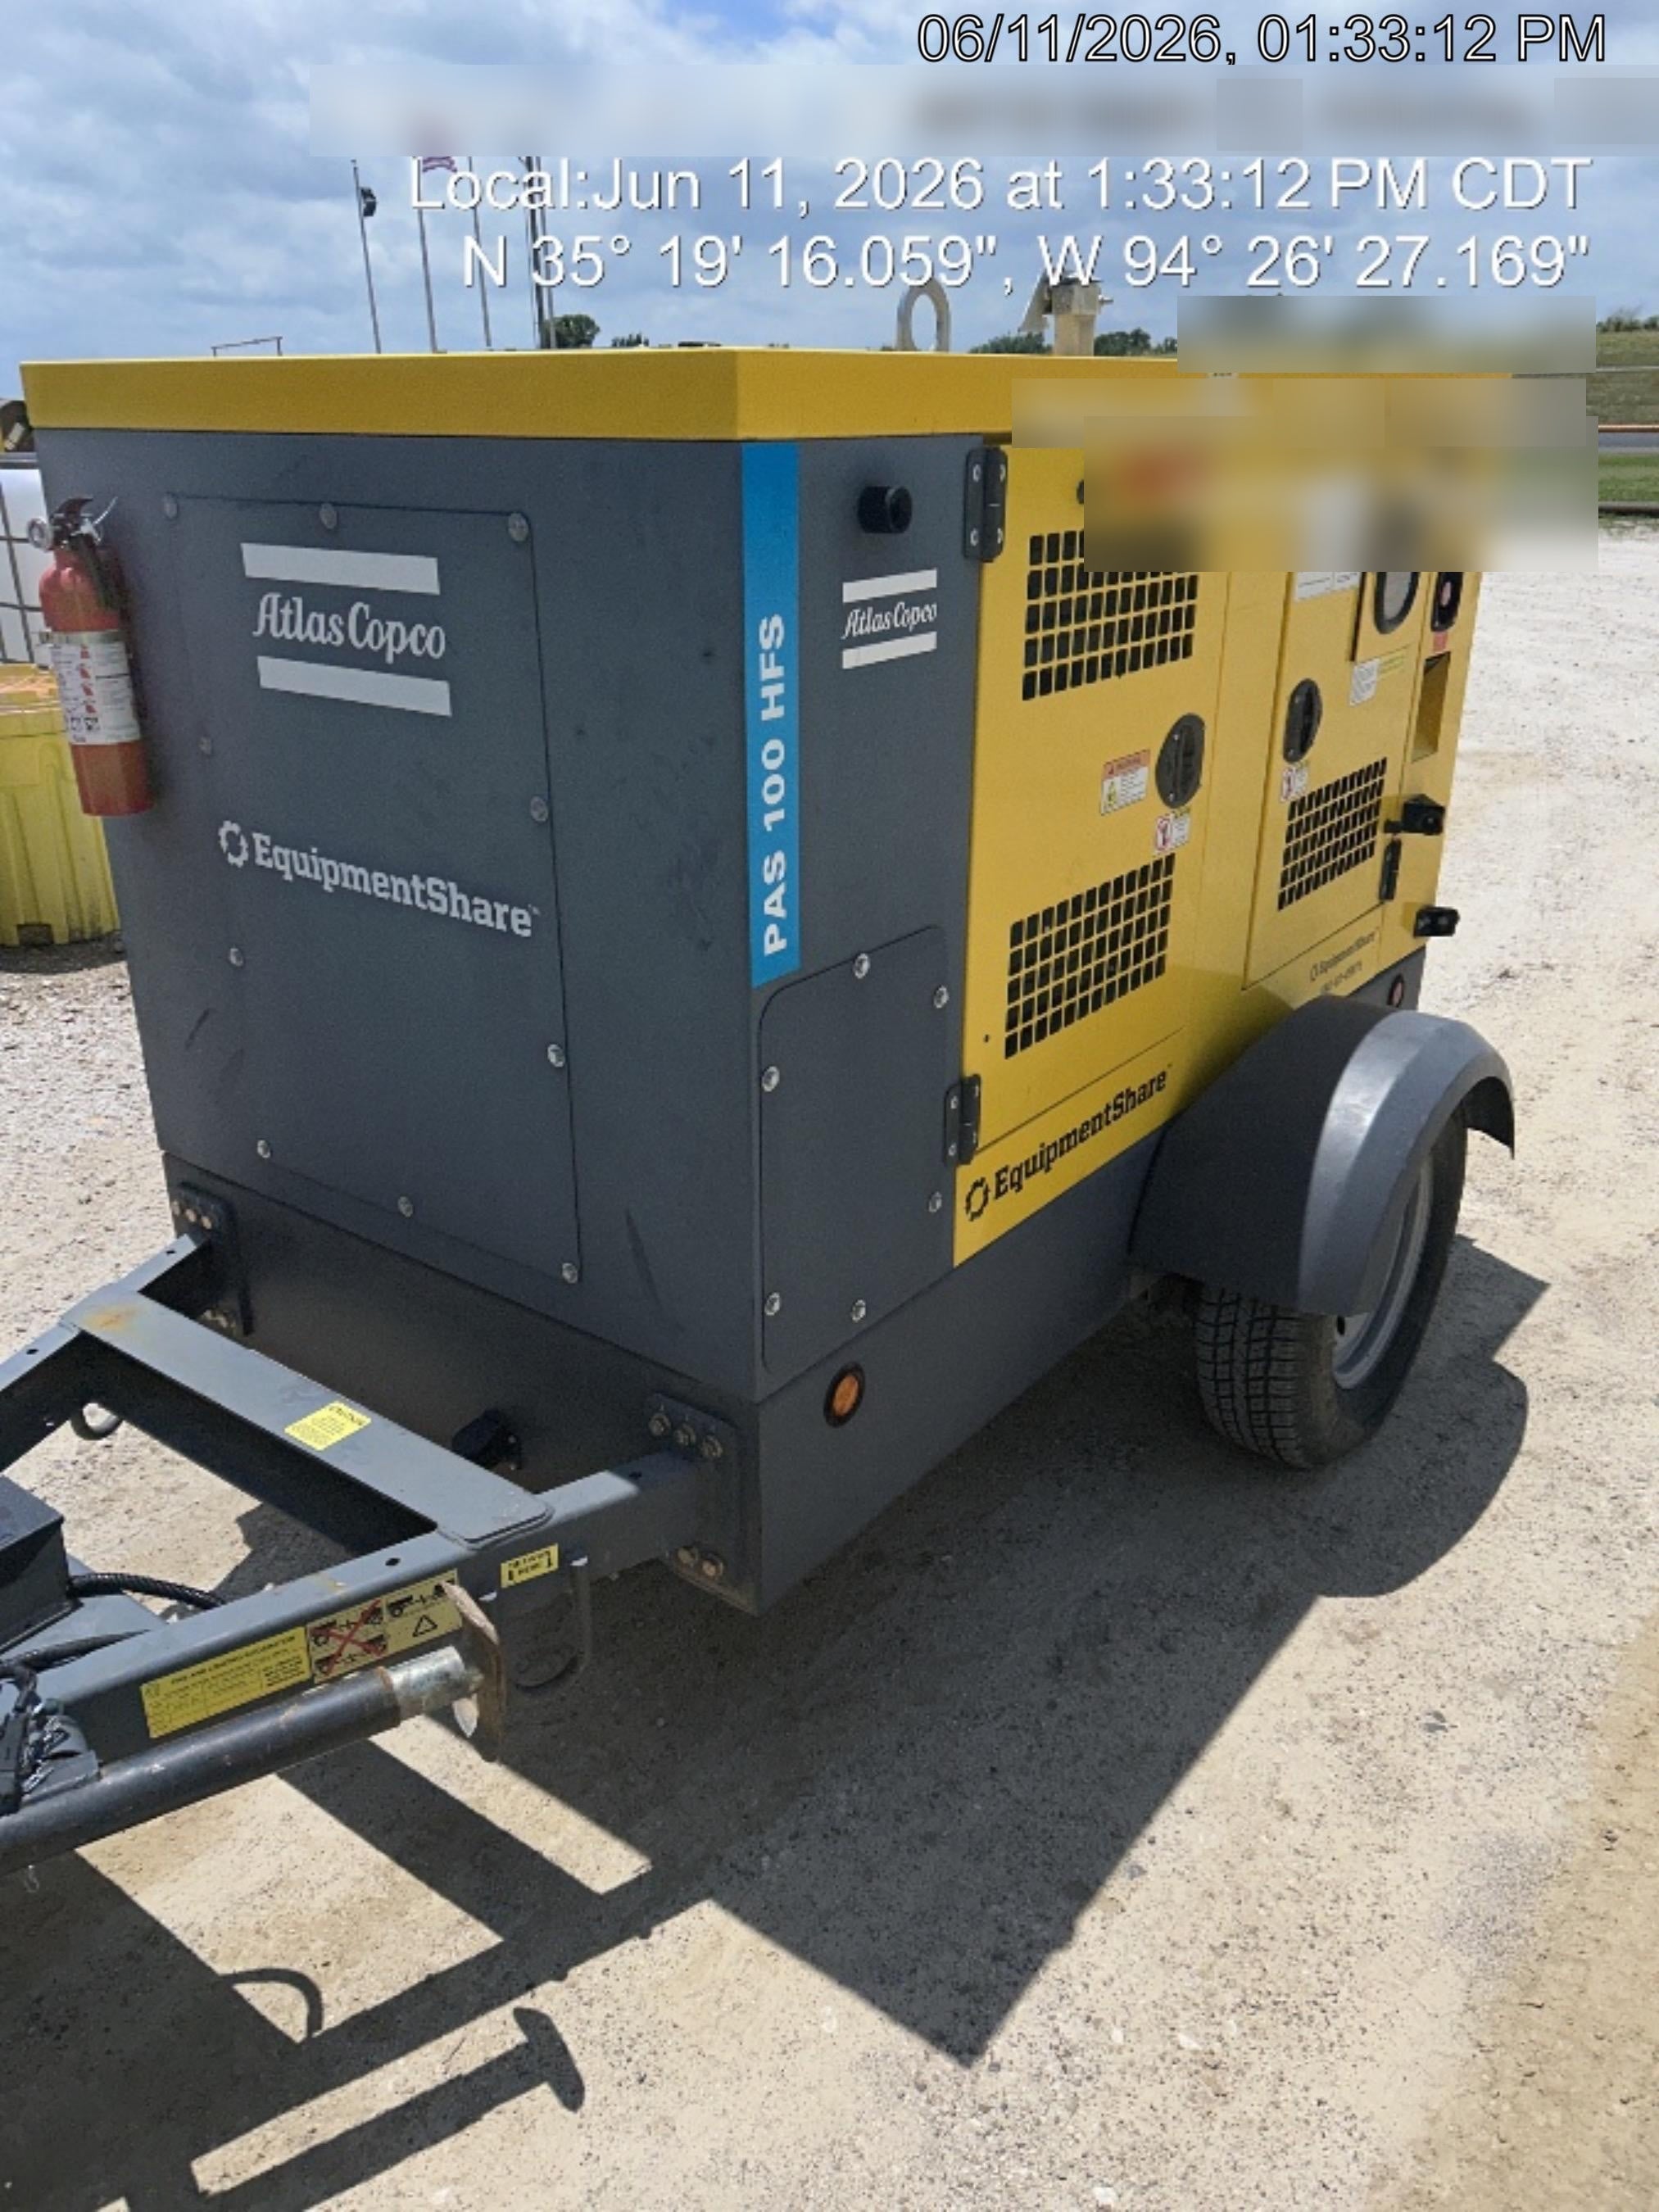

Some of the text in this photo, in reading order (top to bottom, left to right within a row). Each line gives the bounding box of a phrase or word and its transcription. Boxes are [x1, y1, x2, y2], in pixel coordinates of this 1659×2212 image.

[759, 614, 787, 957] PAS 100 HFS
[252, 832, 532, 938] EquipmentShare
[993, 1070, 1167, 1200] EquipmentShare
